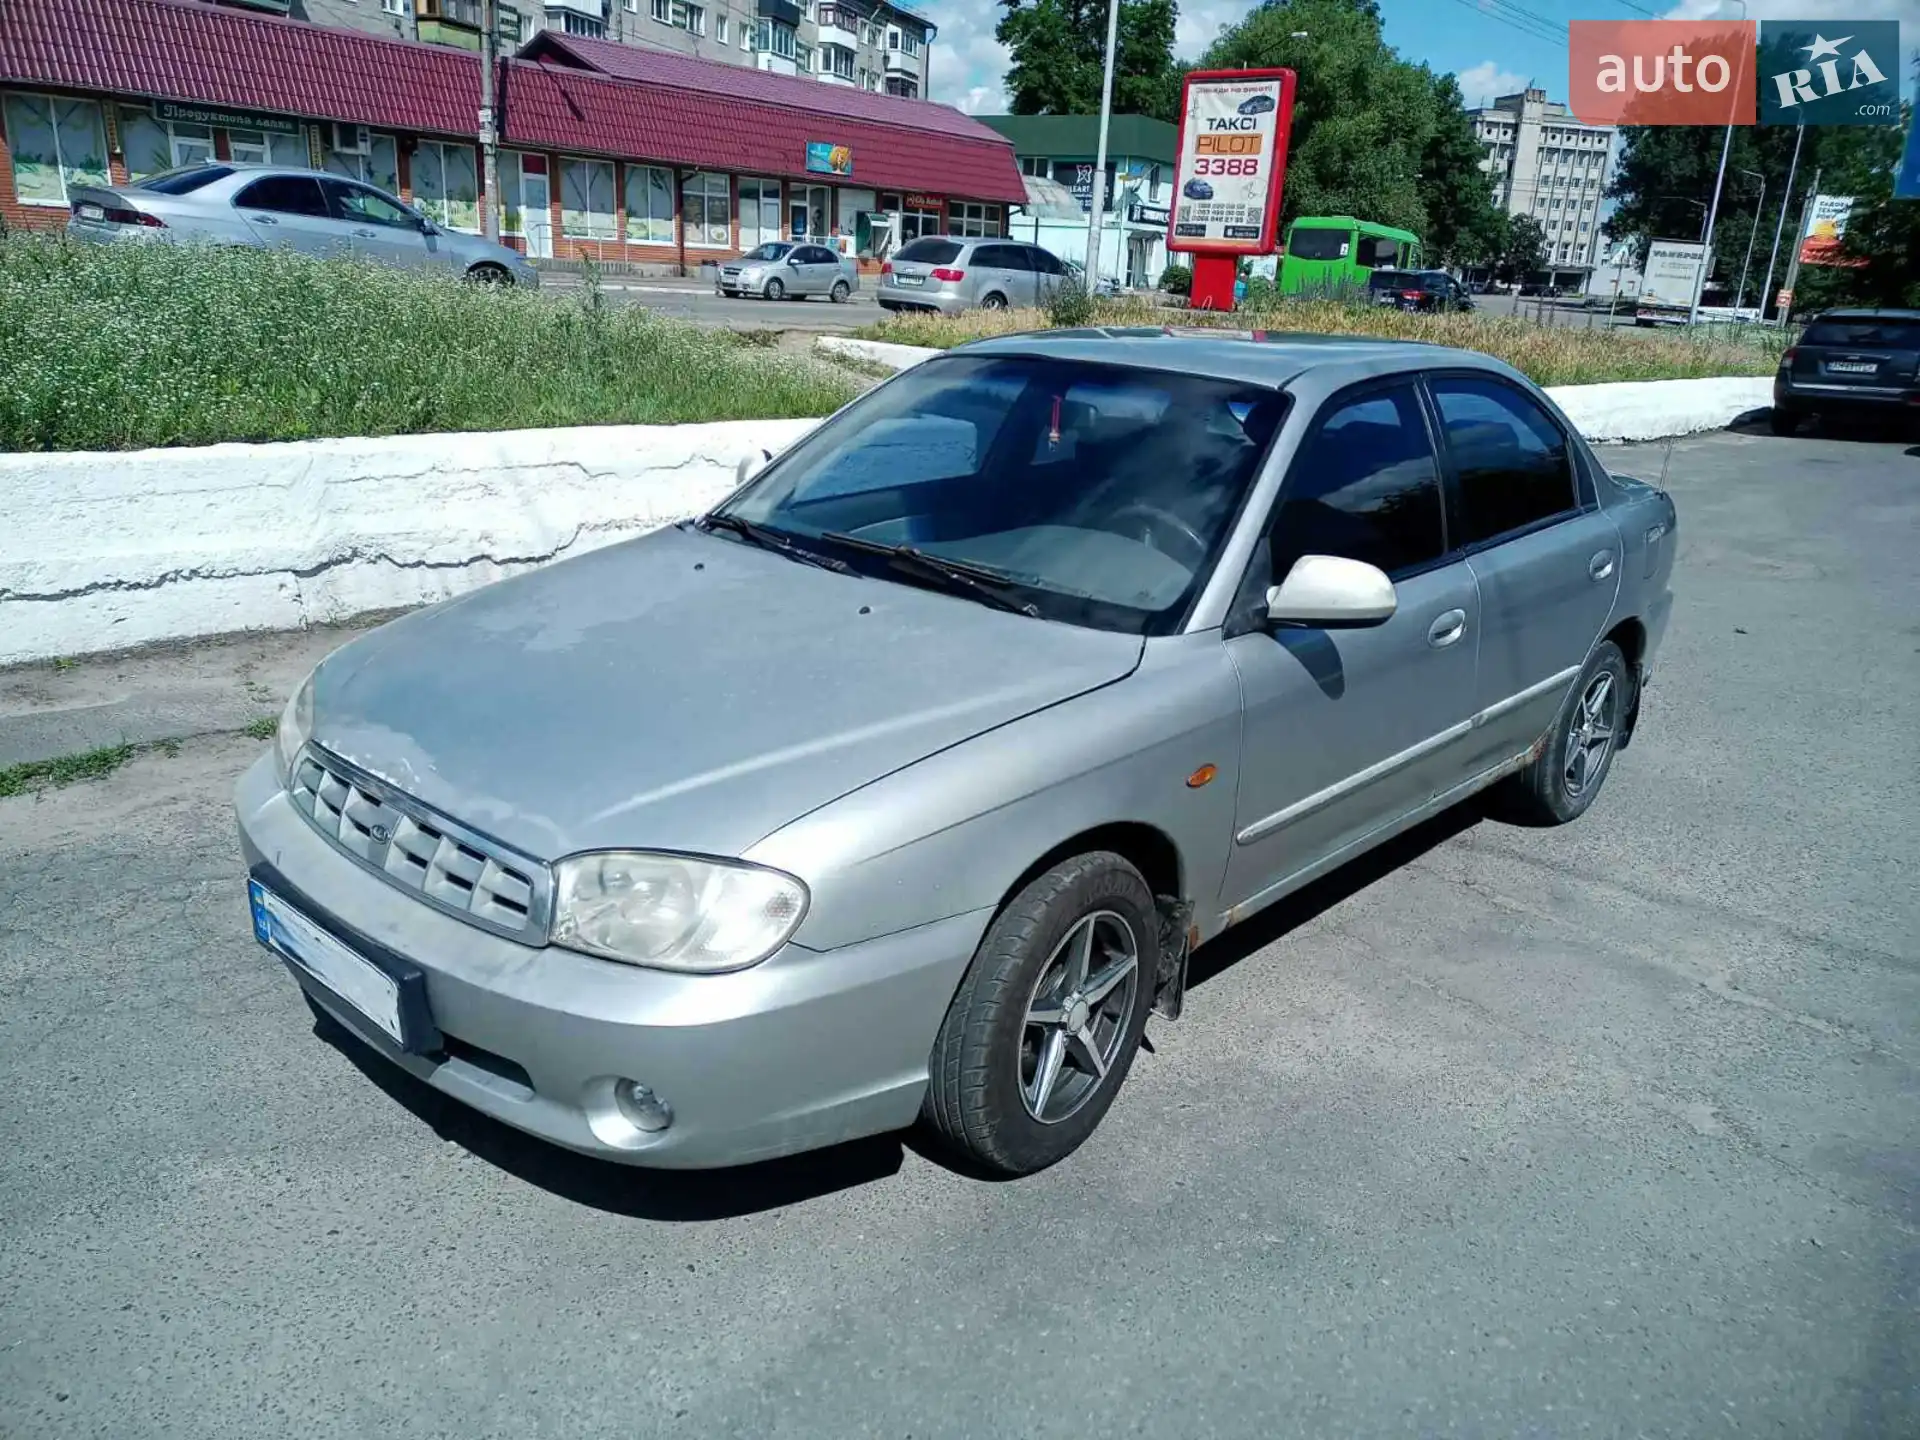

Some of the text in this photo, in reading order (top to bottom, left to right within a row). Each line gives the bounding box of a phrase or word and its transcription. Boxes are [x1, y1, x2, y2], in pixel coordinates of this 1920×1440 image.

[1206, 117, 1257, 131] ТАКСІ
[1198, 136, 1259, 153] PILOT
[1194, 158, 1258, 176] 3388
